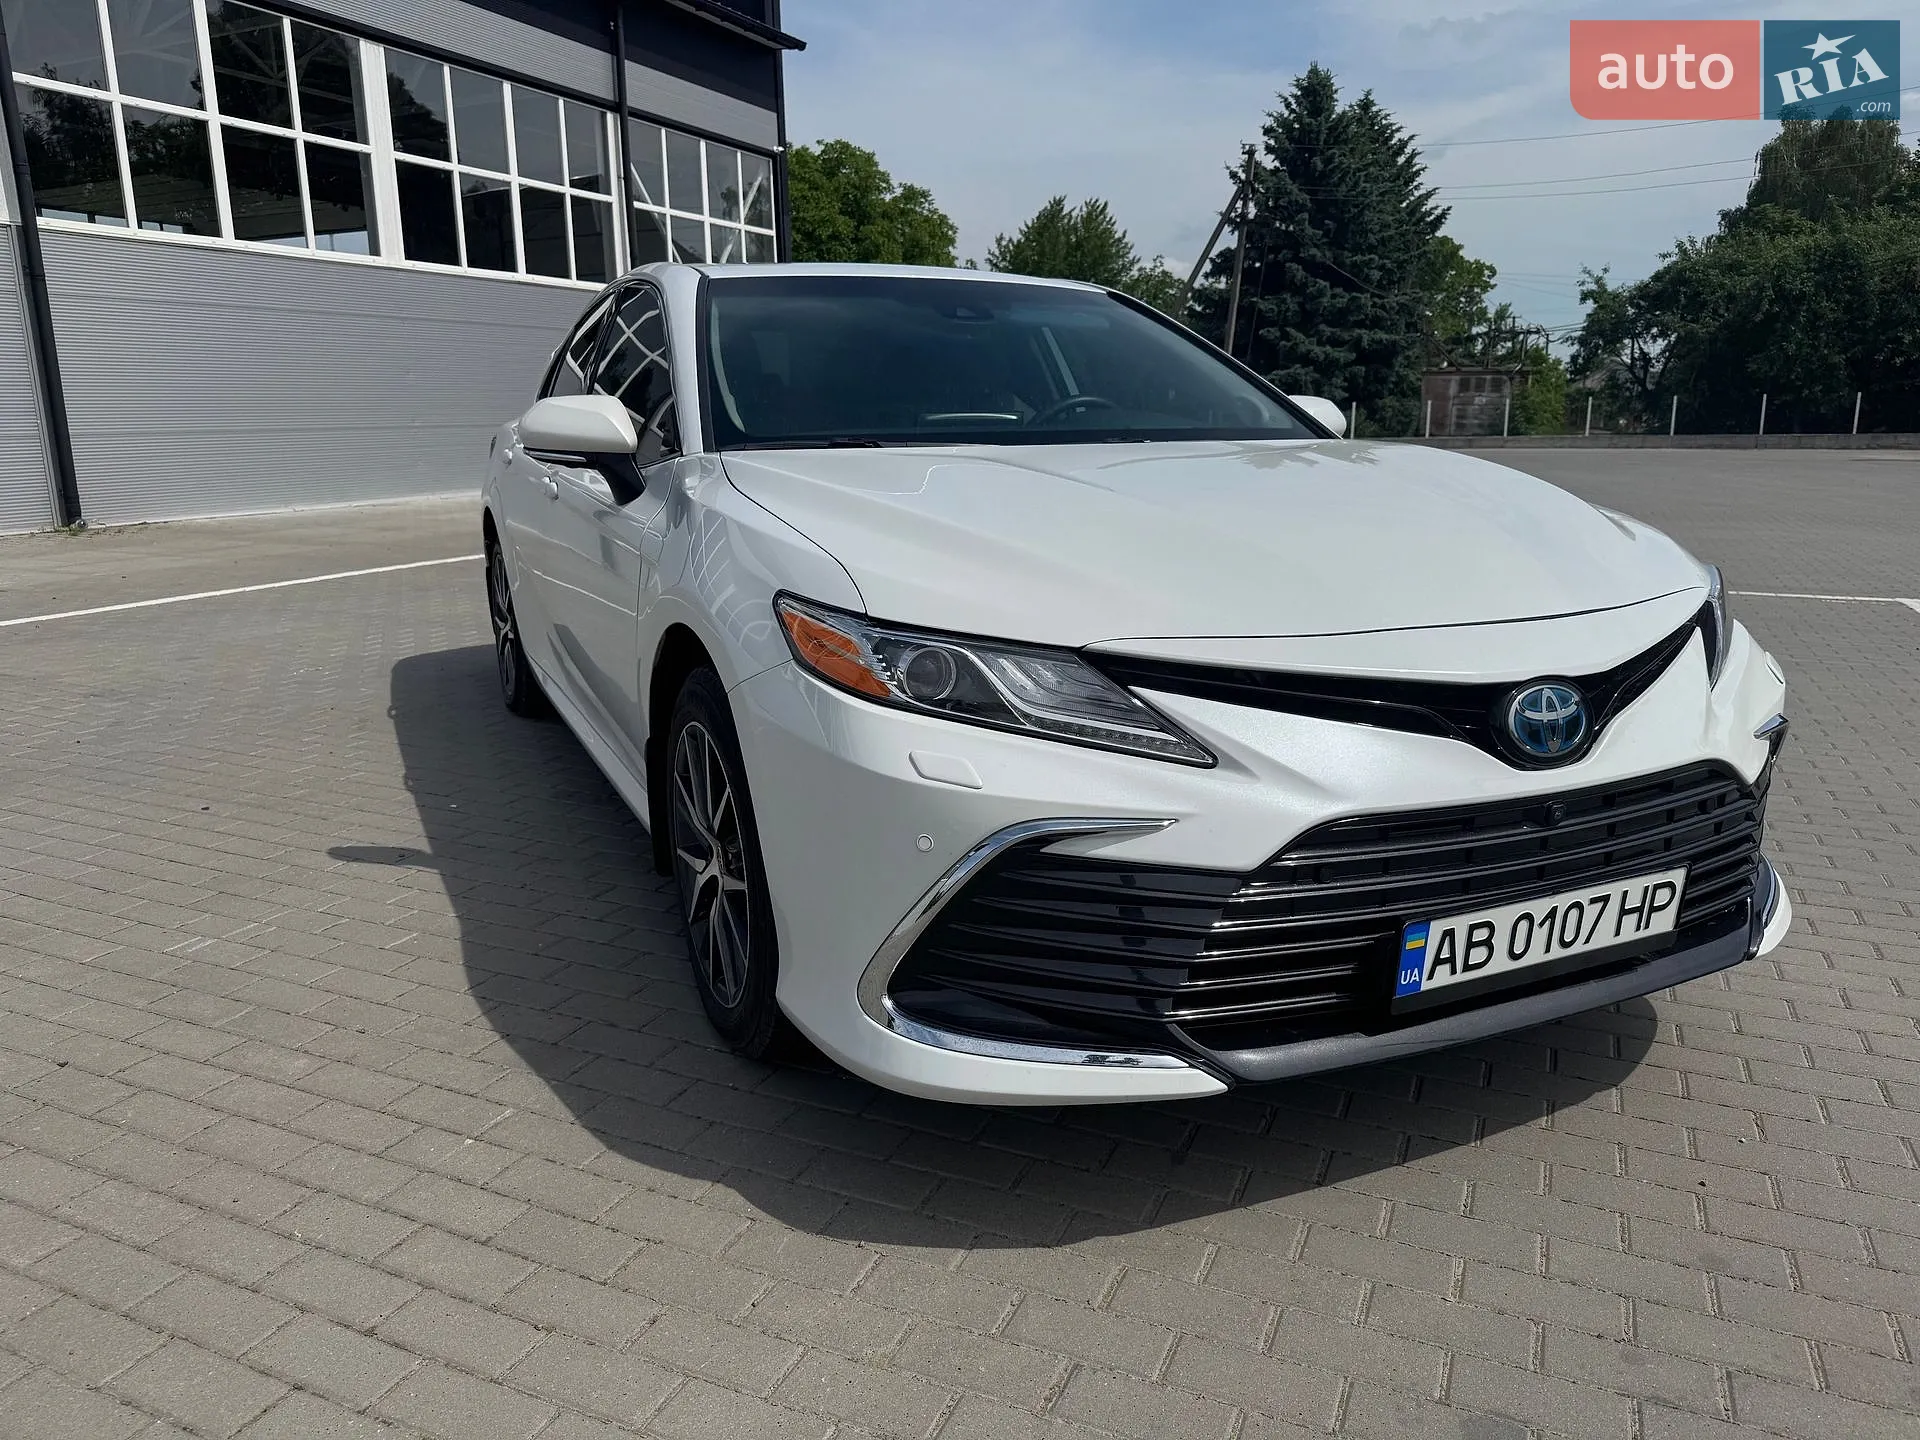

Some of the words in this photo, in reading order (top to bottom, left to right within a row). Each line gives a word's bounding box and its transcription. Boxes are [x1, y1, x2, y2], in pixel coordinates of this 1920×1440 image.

[1426, 920, 1496, 981] AB
[1507, 893, 1611, 961] 0107
[1614, 880, 1677, 938] HP
[1400, 967, 1420, 985] UA
